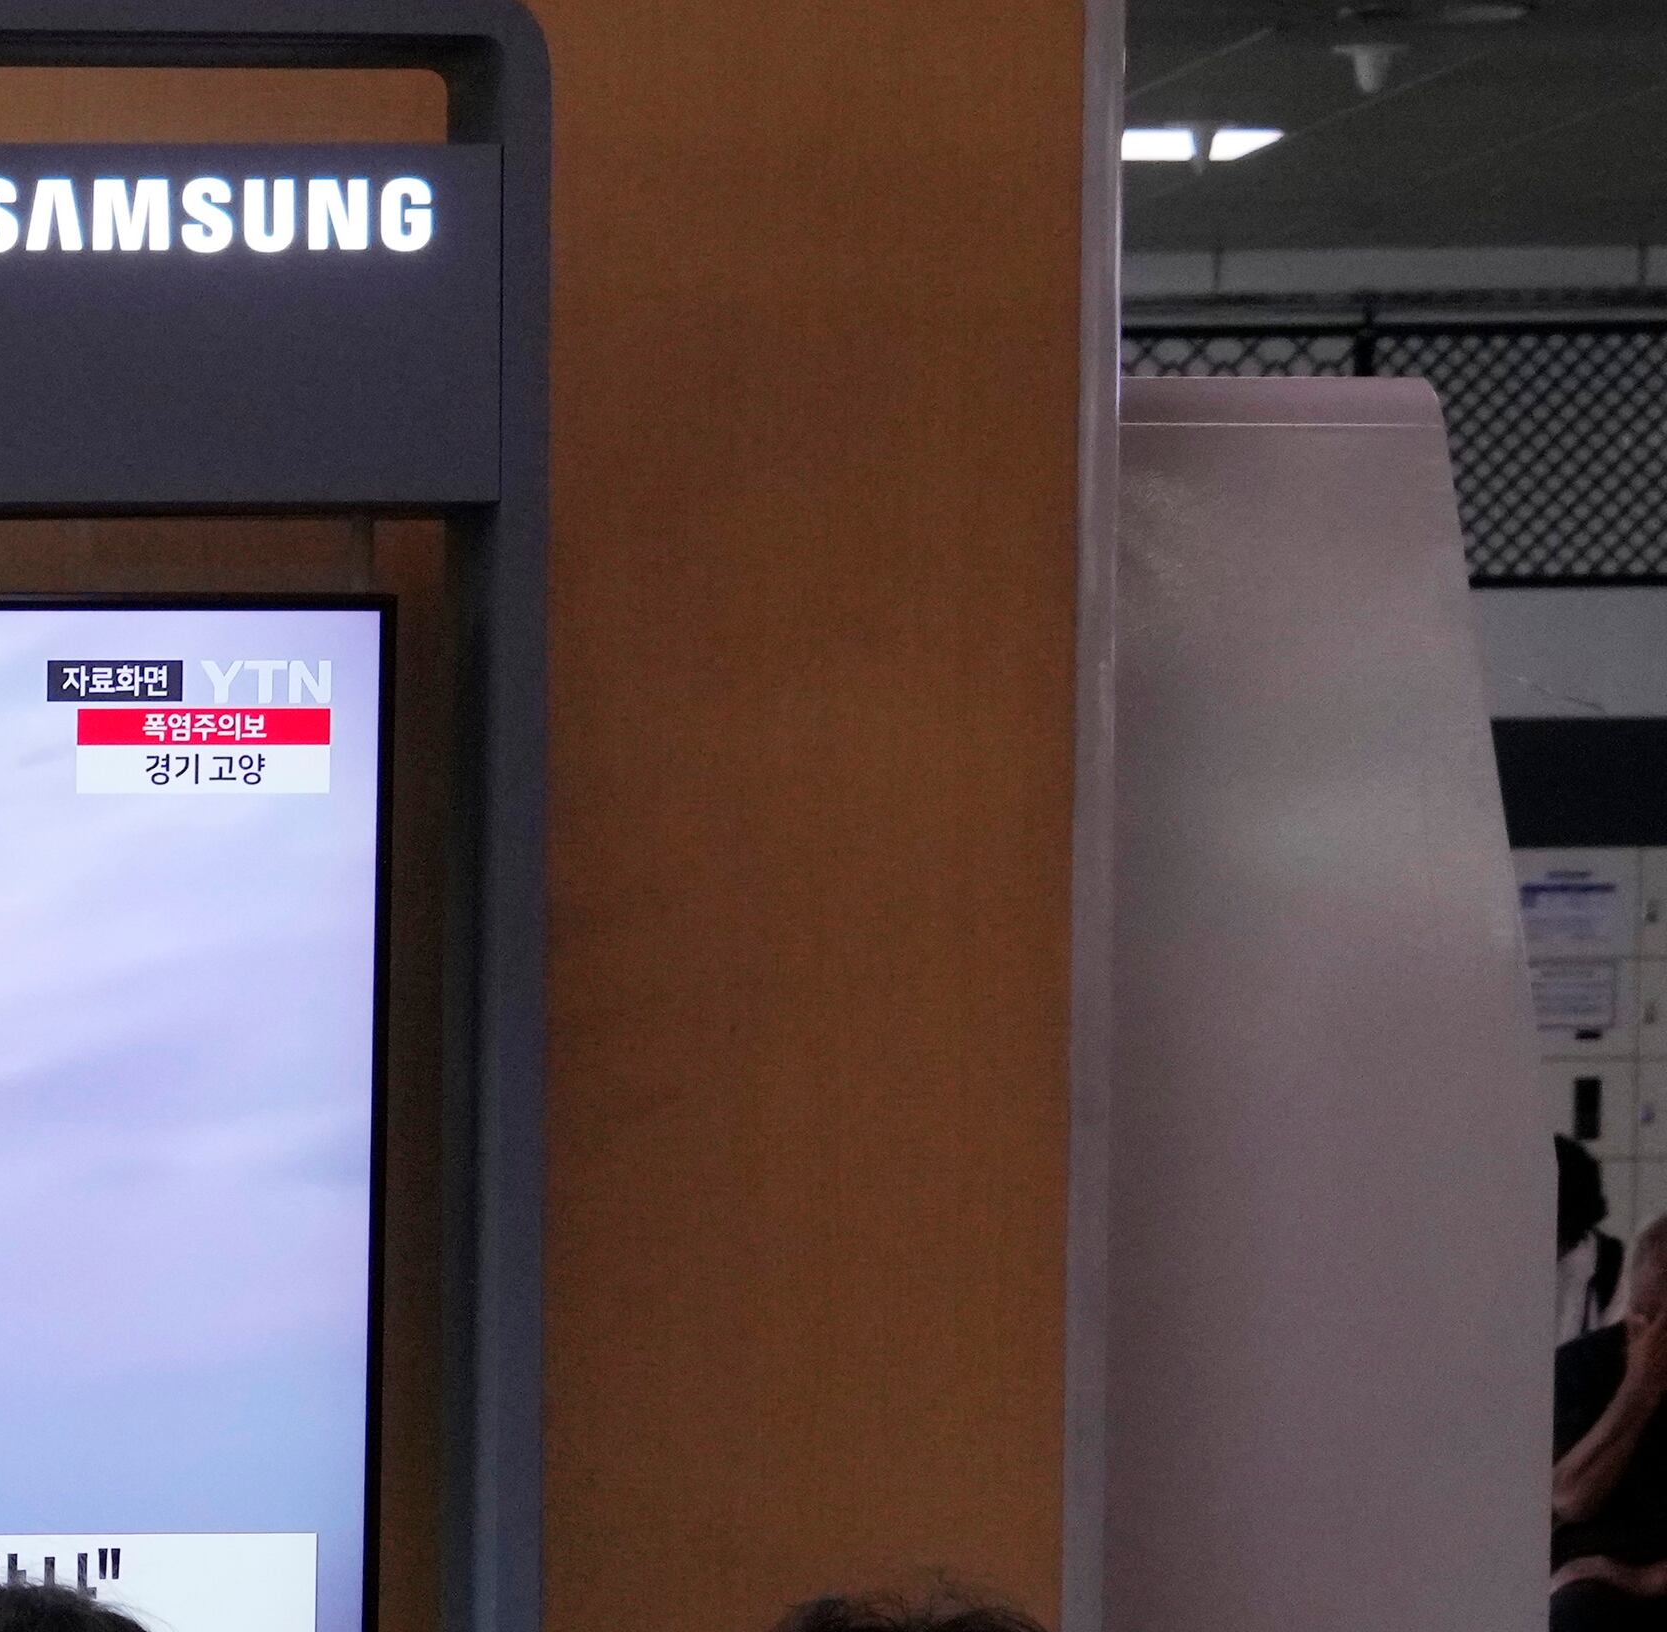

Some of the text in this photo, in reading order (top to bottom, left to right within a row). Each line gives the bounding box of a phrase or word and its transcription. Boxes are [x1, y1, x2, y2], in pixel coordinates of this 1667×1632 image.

[61, 664, 169, 697] 자료화면
[201, 660, 331, 704] YTN
[142, 712, 267, 742] 폭염주의보
[144, 752, 266, 785] 경기 고양
